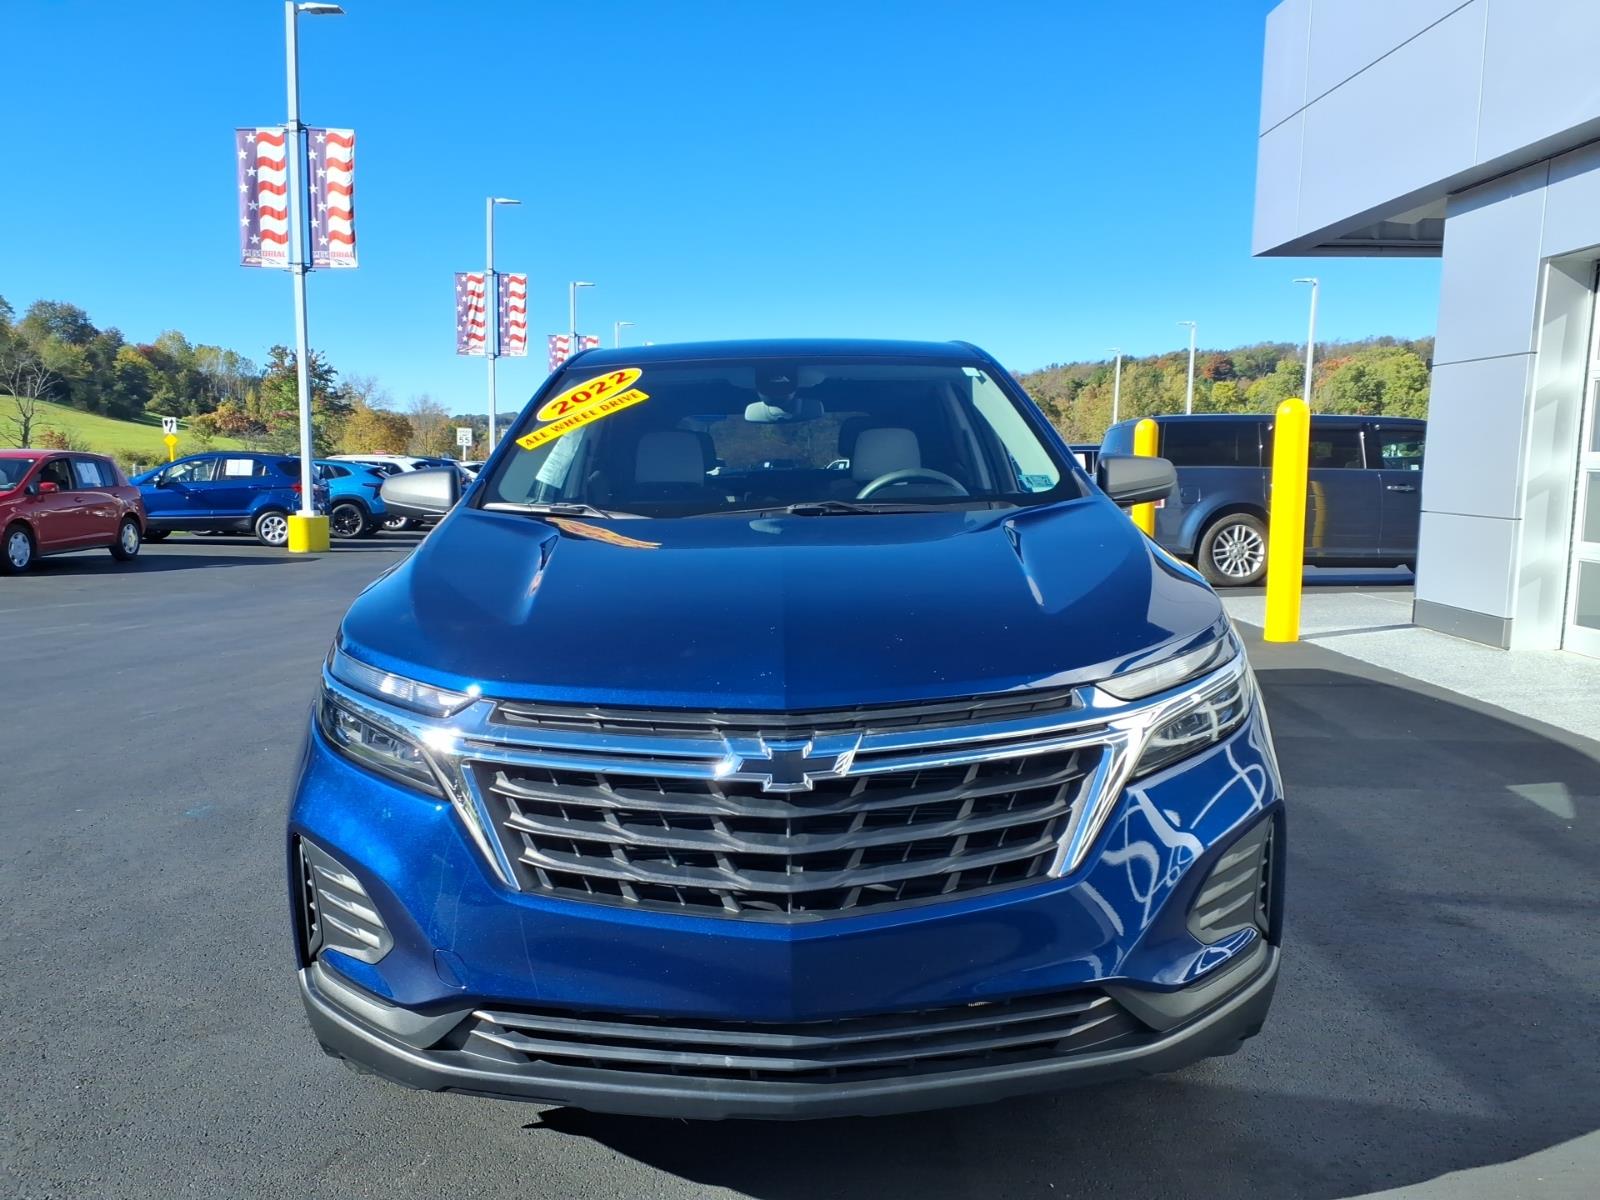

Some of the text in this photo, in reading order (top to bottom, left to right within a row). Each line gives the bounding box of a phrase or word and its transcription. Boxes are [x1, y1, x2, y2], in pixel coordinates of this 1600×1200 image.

[551, 371, 632, 415] 2022
[459, 436, 471, 444] 55
[525, 392, 640, 446] ALL WHEEL DRIVE
